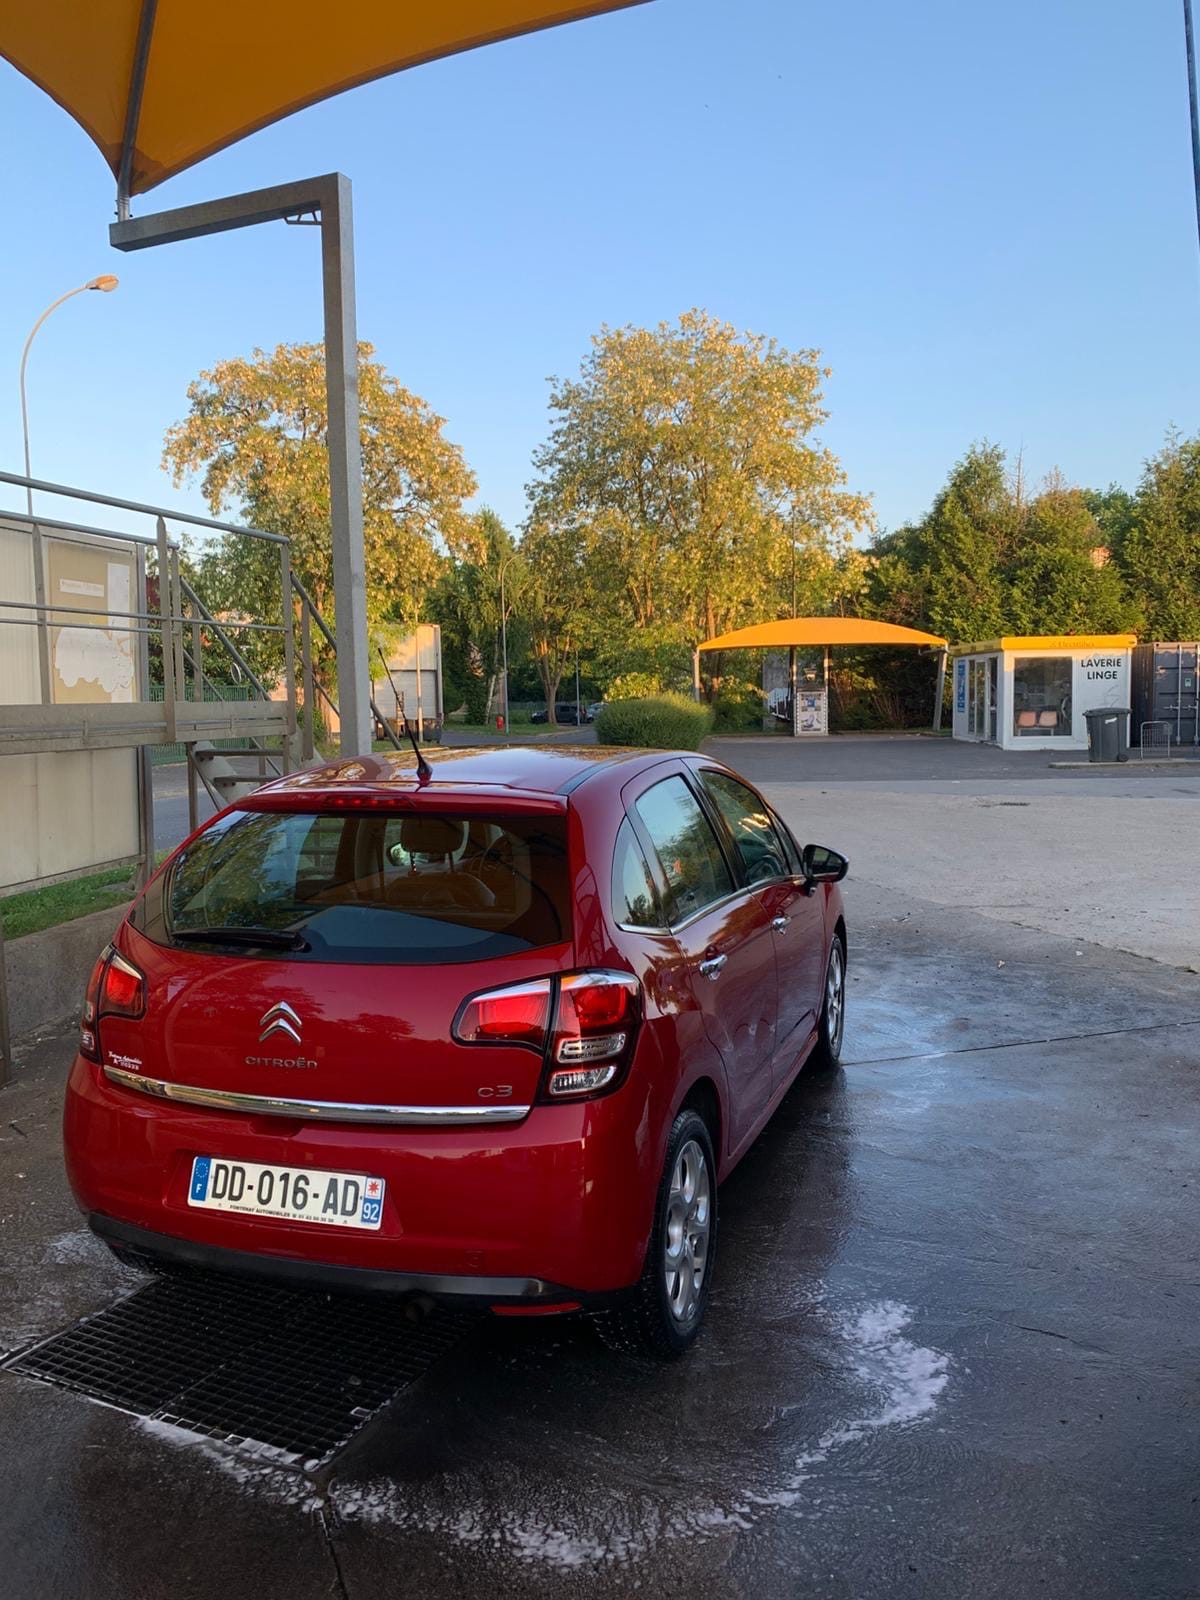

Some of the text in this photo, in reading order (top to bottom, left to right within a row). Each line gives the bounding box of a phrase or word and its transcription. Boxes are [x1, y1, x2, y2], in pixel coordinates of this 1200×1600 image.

[1081, 658, 1122, 667] LAVERIE
[1087, 671, 1118, 680] LINGE
[477, 1085, 513, 1097] C3
[196, 1184, 203, 1194] F
[211, 1163, 360, 1216] DD-016-AD
[255, 1208, 290, 1218] AUTOMOBILES
[362, 1202, 379, 1221] 92
